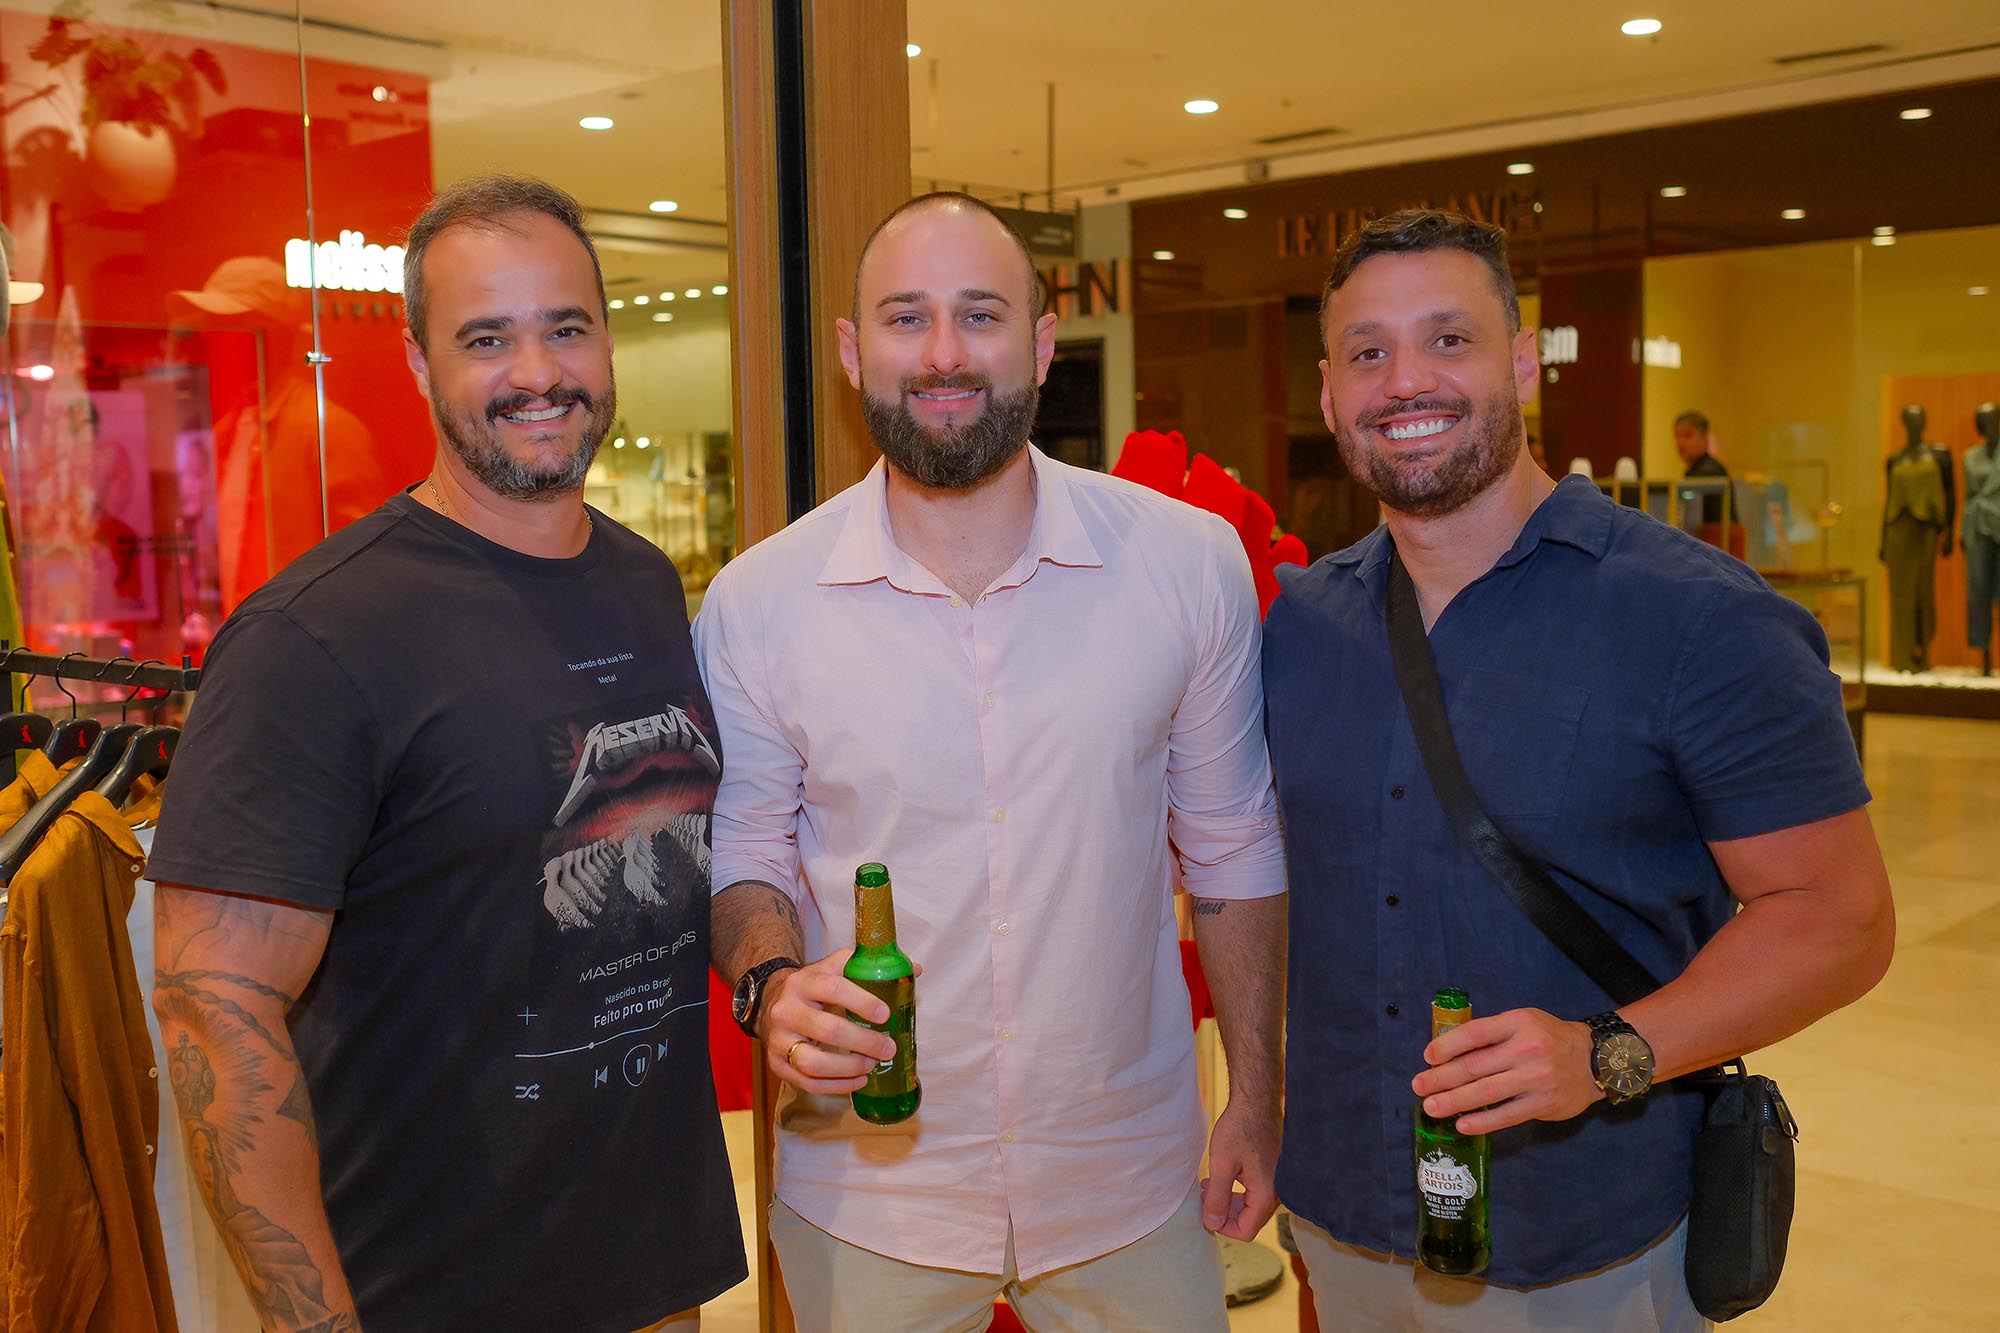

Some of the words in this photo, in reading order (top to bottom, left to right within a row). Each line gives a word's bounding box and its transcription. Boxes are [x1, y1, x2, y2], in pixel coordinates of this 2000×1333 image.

[567, 659, 597, 671] Tocando
[597, 657, 607, 665] da
[606, 654, 619, 664] sua
[618, 652, 634, 661] lista
[598, 673, 618, 684] Metal
[552, 703, 720, 827] RESERVA
[579, 952, 643, 983] MASTER
[646, 945, 669, 962] OF
[604, 986, 636, 1005] Nascido
[638, 983, 650, 993] no
[593, 1009, 621, 1028] Feito
[622, 1002, 643, 1019] pro
[1424, 1168, 1463, 1182] STELLA
[1424, 1178, 1463, 1190] ARTOIS
[1424, 1194, 1442, 1204] PURE
[1444, 1198, 1467, 1206] GOLD
